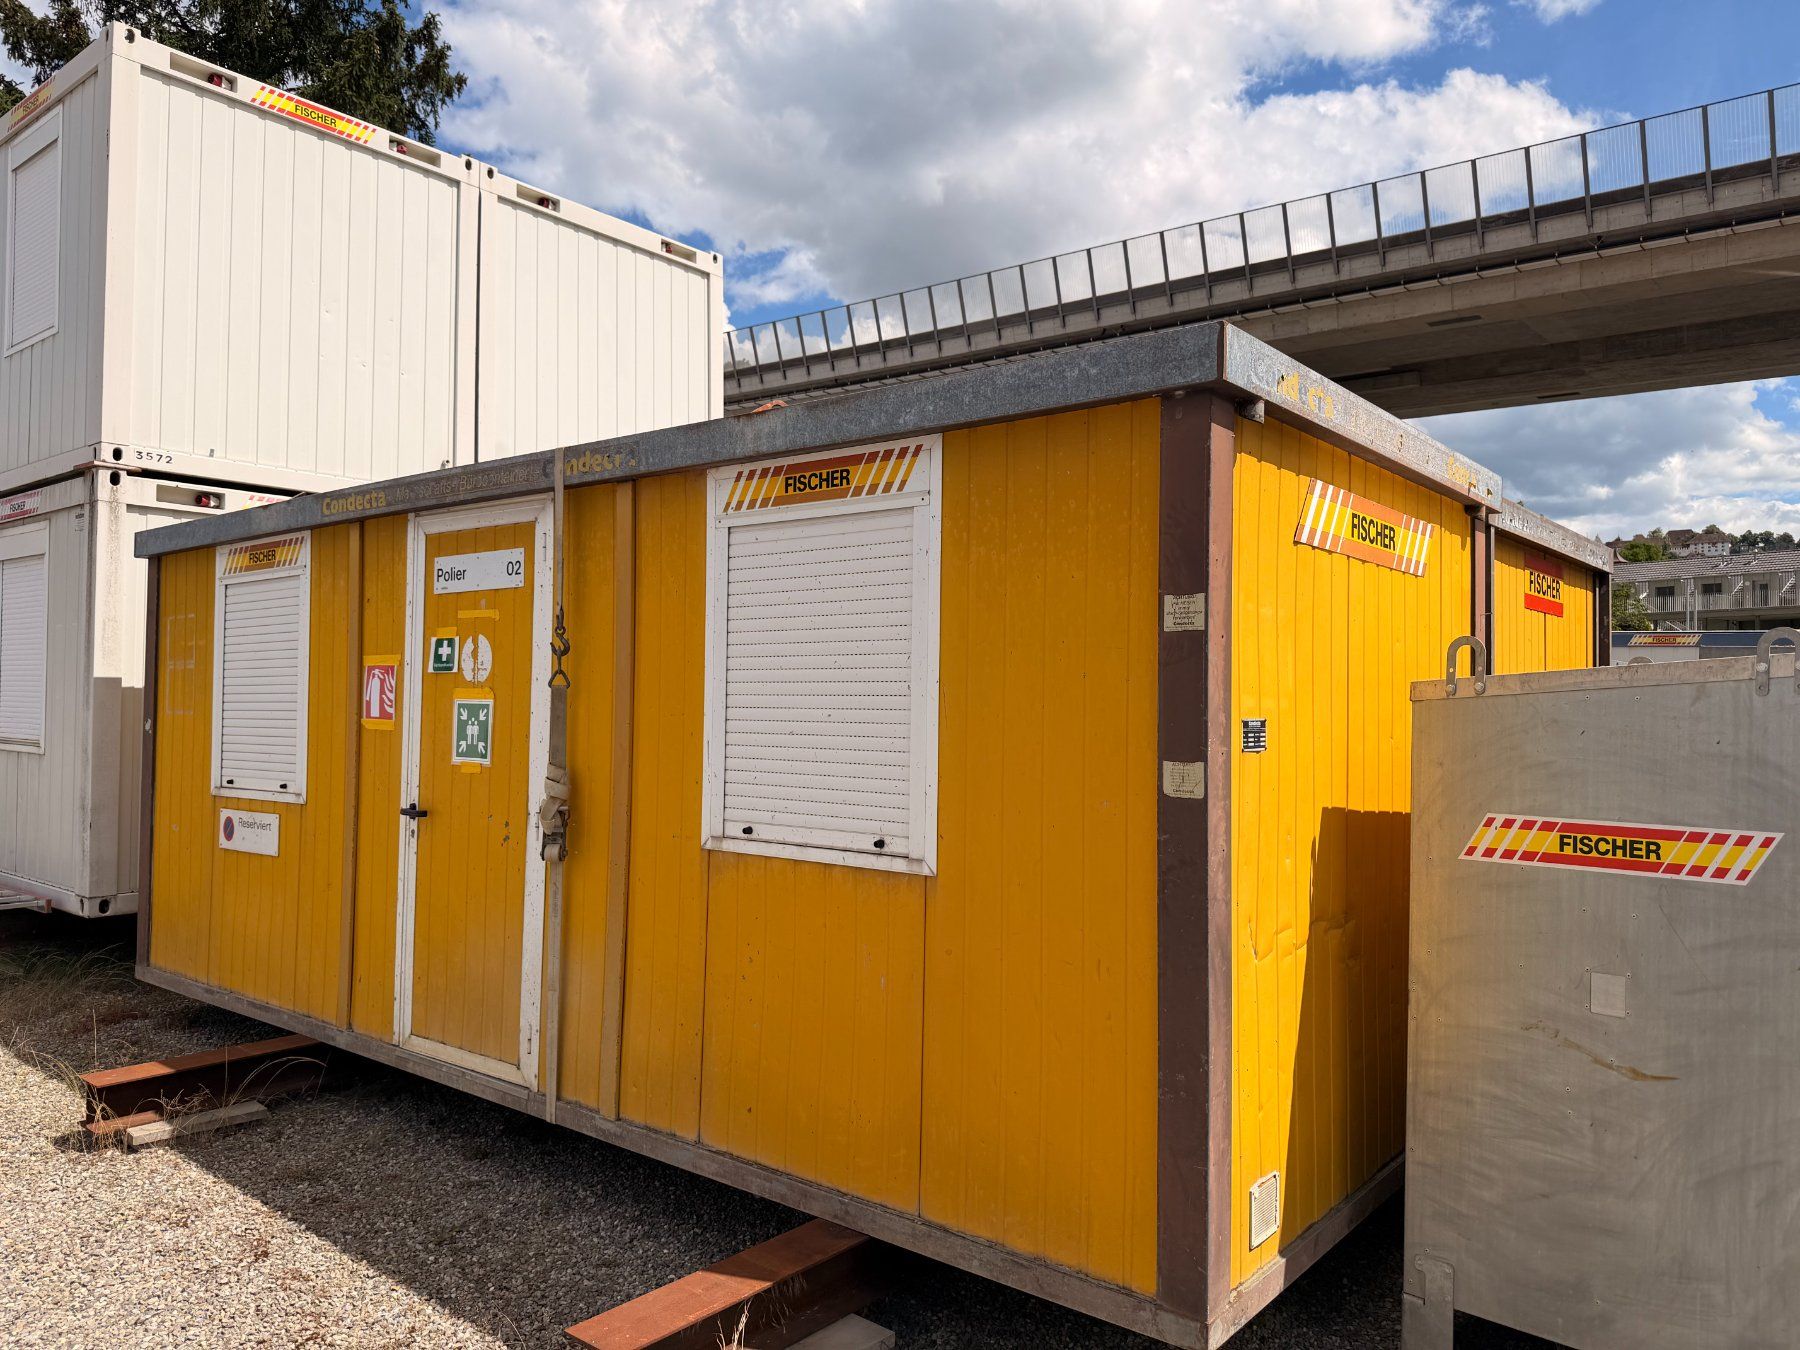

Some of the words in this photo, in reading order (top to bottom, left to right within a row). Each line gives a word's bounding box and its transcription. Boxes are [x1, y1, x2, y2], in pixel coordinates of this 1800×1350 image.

[295, 105, 337, 127] FISCHER
[135, 450, 173, 464] 3572
[784, 468, 851, 494] FISCHER
[10, 500, 26, 513] FISCHER
[322, 488, 386, 515] Condecta
[1351, 512, 1396, 551] FISCHER
[248, 549, 276, 565] FISCHER
[436, 566, 467, 583] Polier
[506, 560, 522, 576] 02
[1529, 570, 1561, 600] FISCHER
[1652, 636, 1677, 644] FISCHER
[238, 817, 272, 832] Reserviert
[1558, 834, 1662, 861] FISCHER
